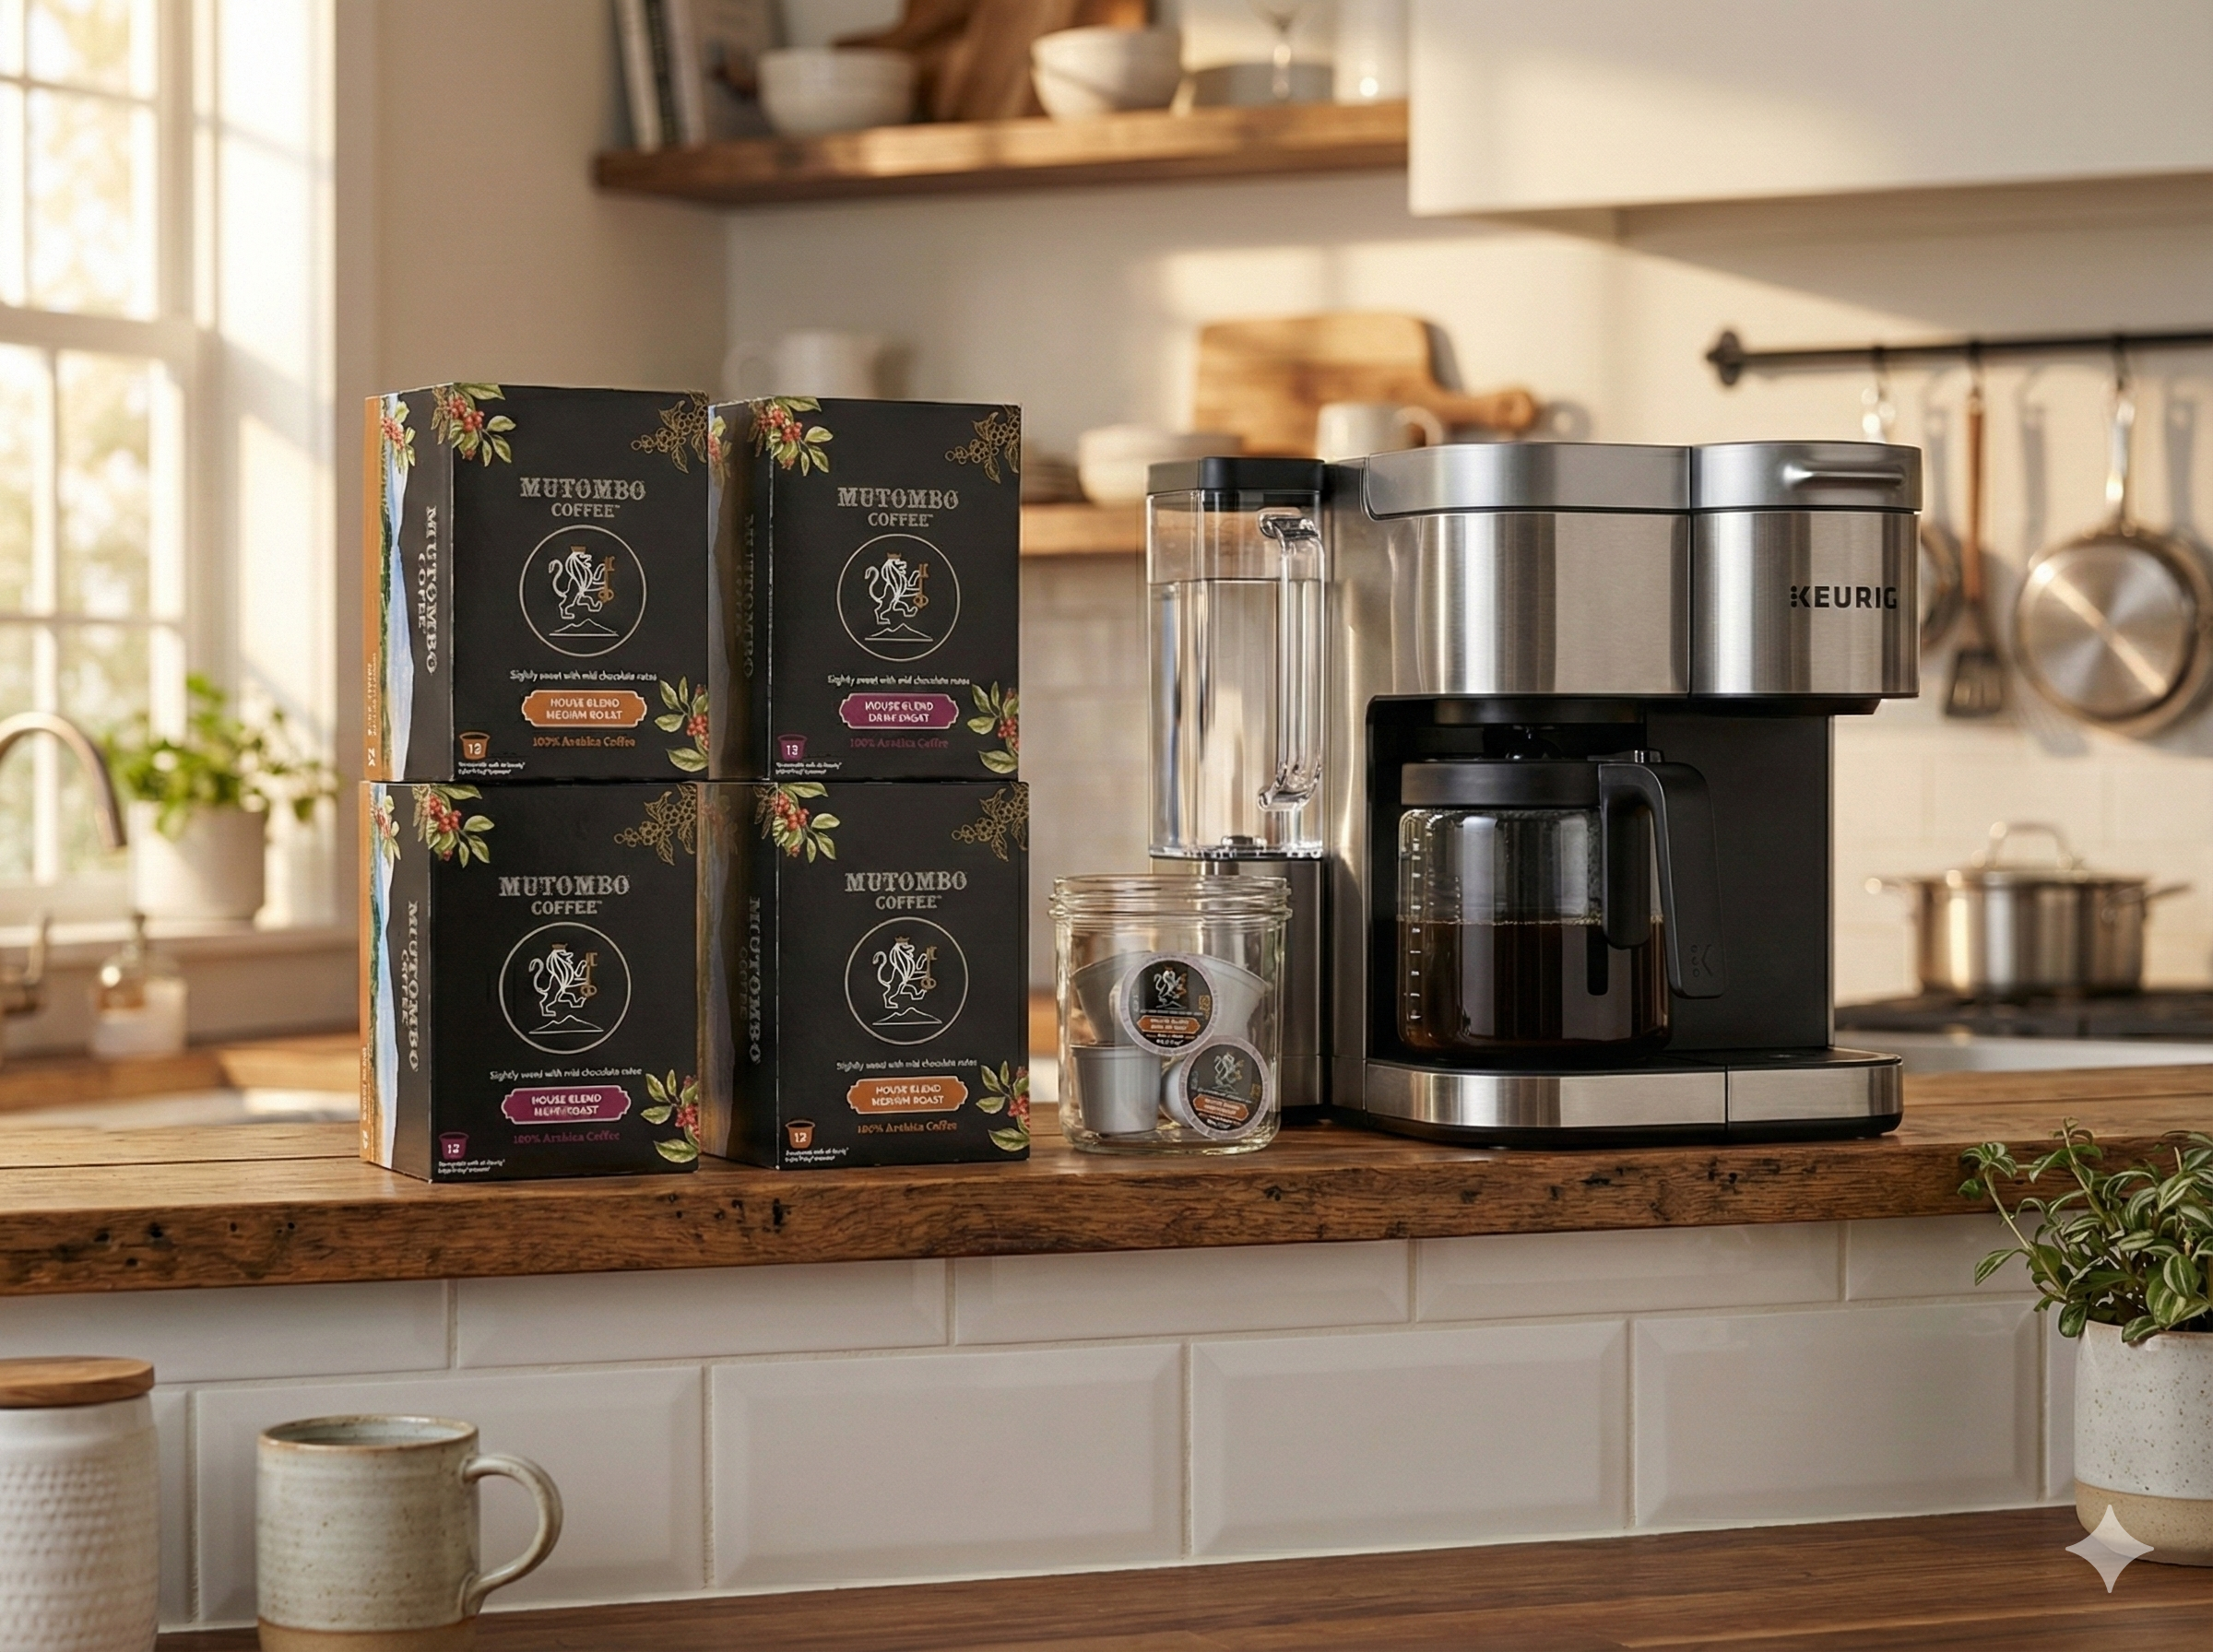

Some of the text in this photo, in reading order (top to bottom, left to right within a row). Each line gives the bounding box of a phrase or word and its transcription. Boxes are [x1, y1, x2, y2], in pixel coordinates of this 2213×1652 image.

[520, 478, 645, 501] MUTOMBO
[837, 488, 959, 509] MUTOMBO
[1791, 585, 1897, 609] KEURIG
[498, 875, 630, 896] MUTOMBO
[845, 871, 967, 891] MUTOMBO
[794, 1132, 807, 1142] 12
